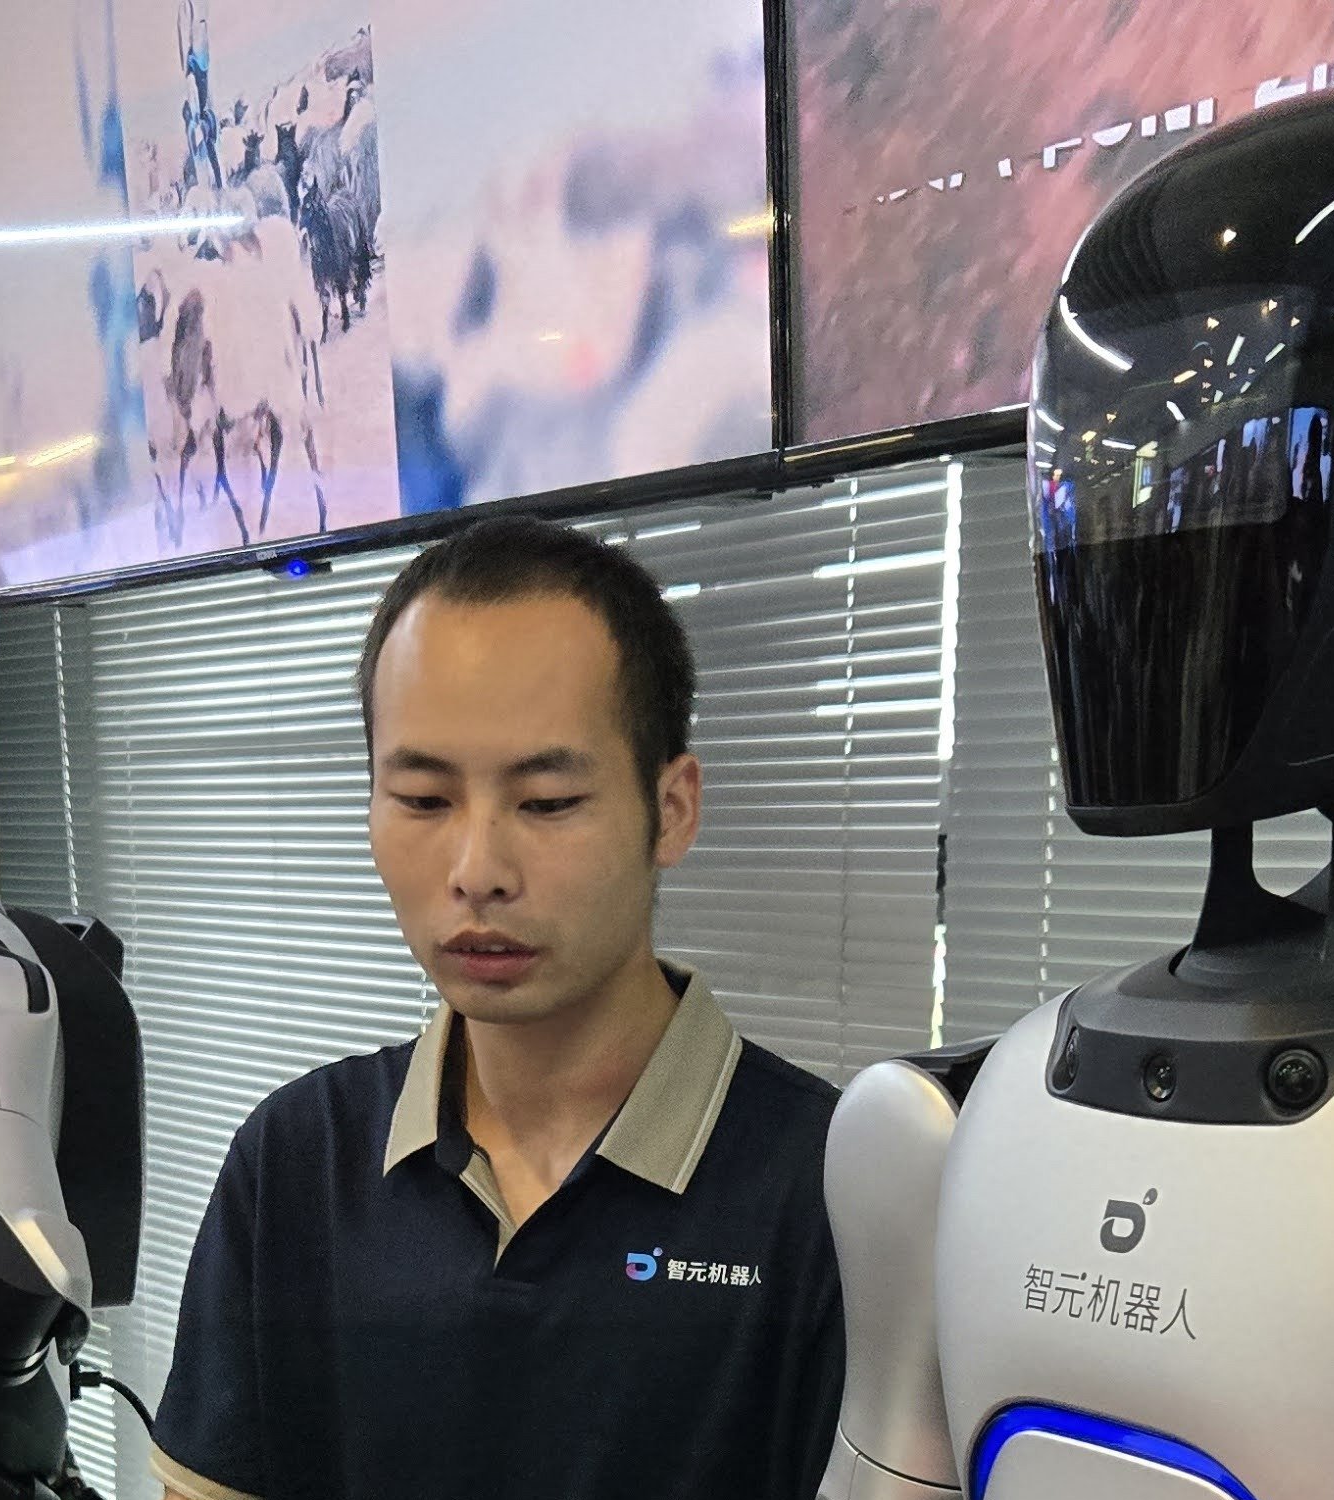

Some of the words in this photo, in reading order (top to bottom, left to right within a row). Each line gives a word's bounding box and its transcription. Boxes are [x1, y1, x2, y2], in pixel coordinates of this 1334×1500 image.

[667, 1258, 762, 1286] 智元机器人
[1024, 1263, 1196, 1340] 智元机器人
